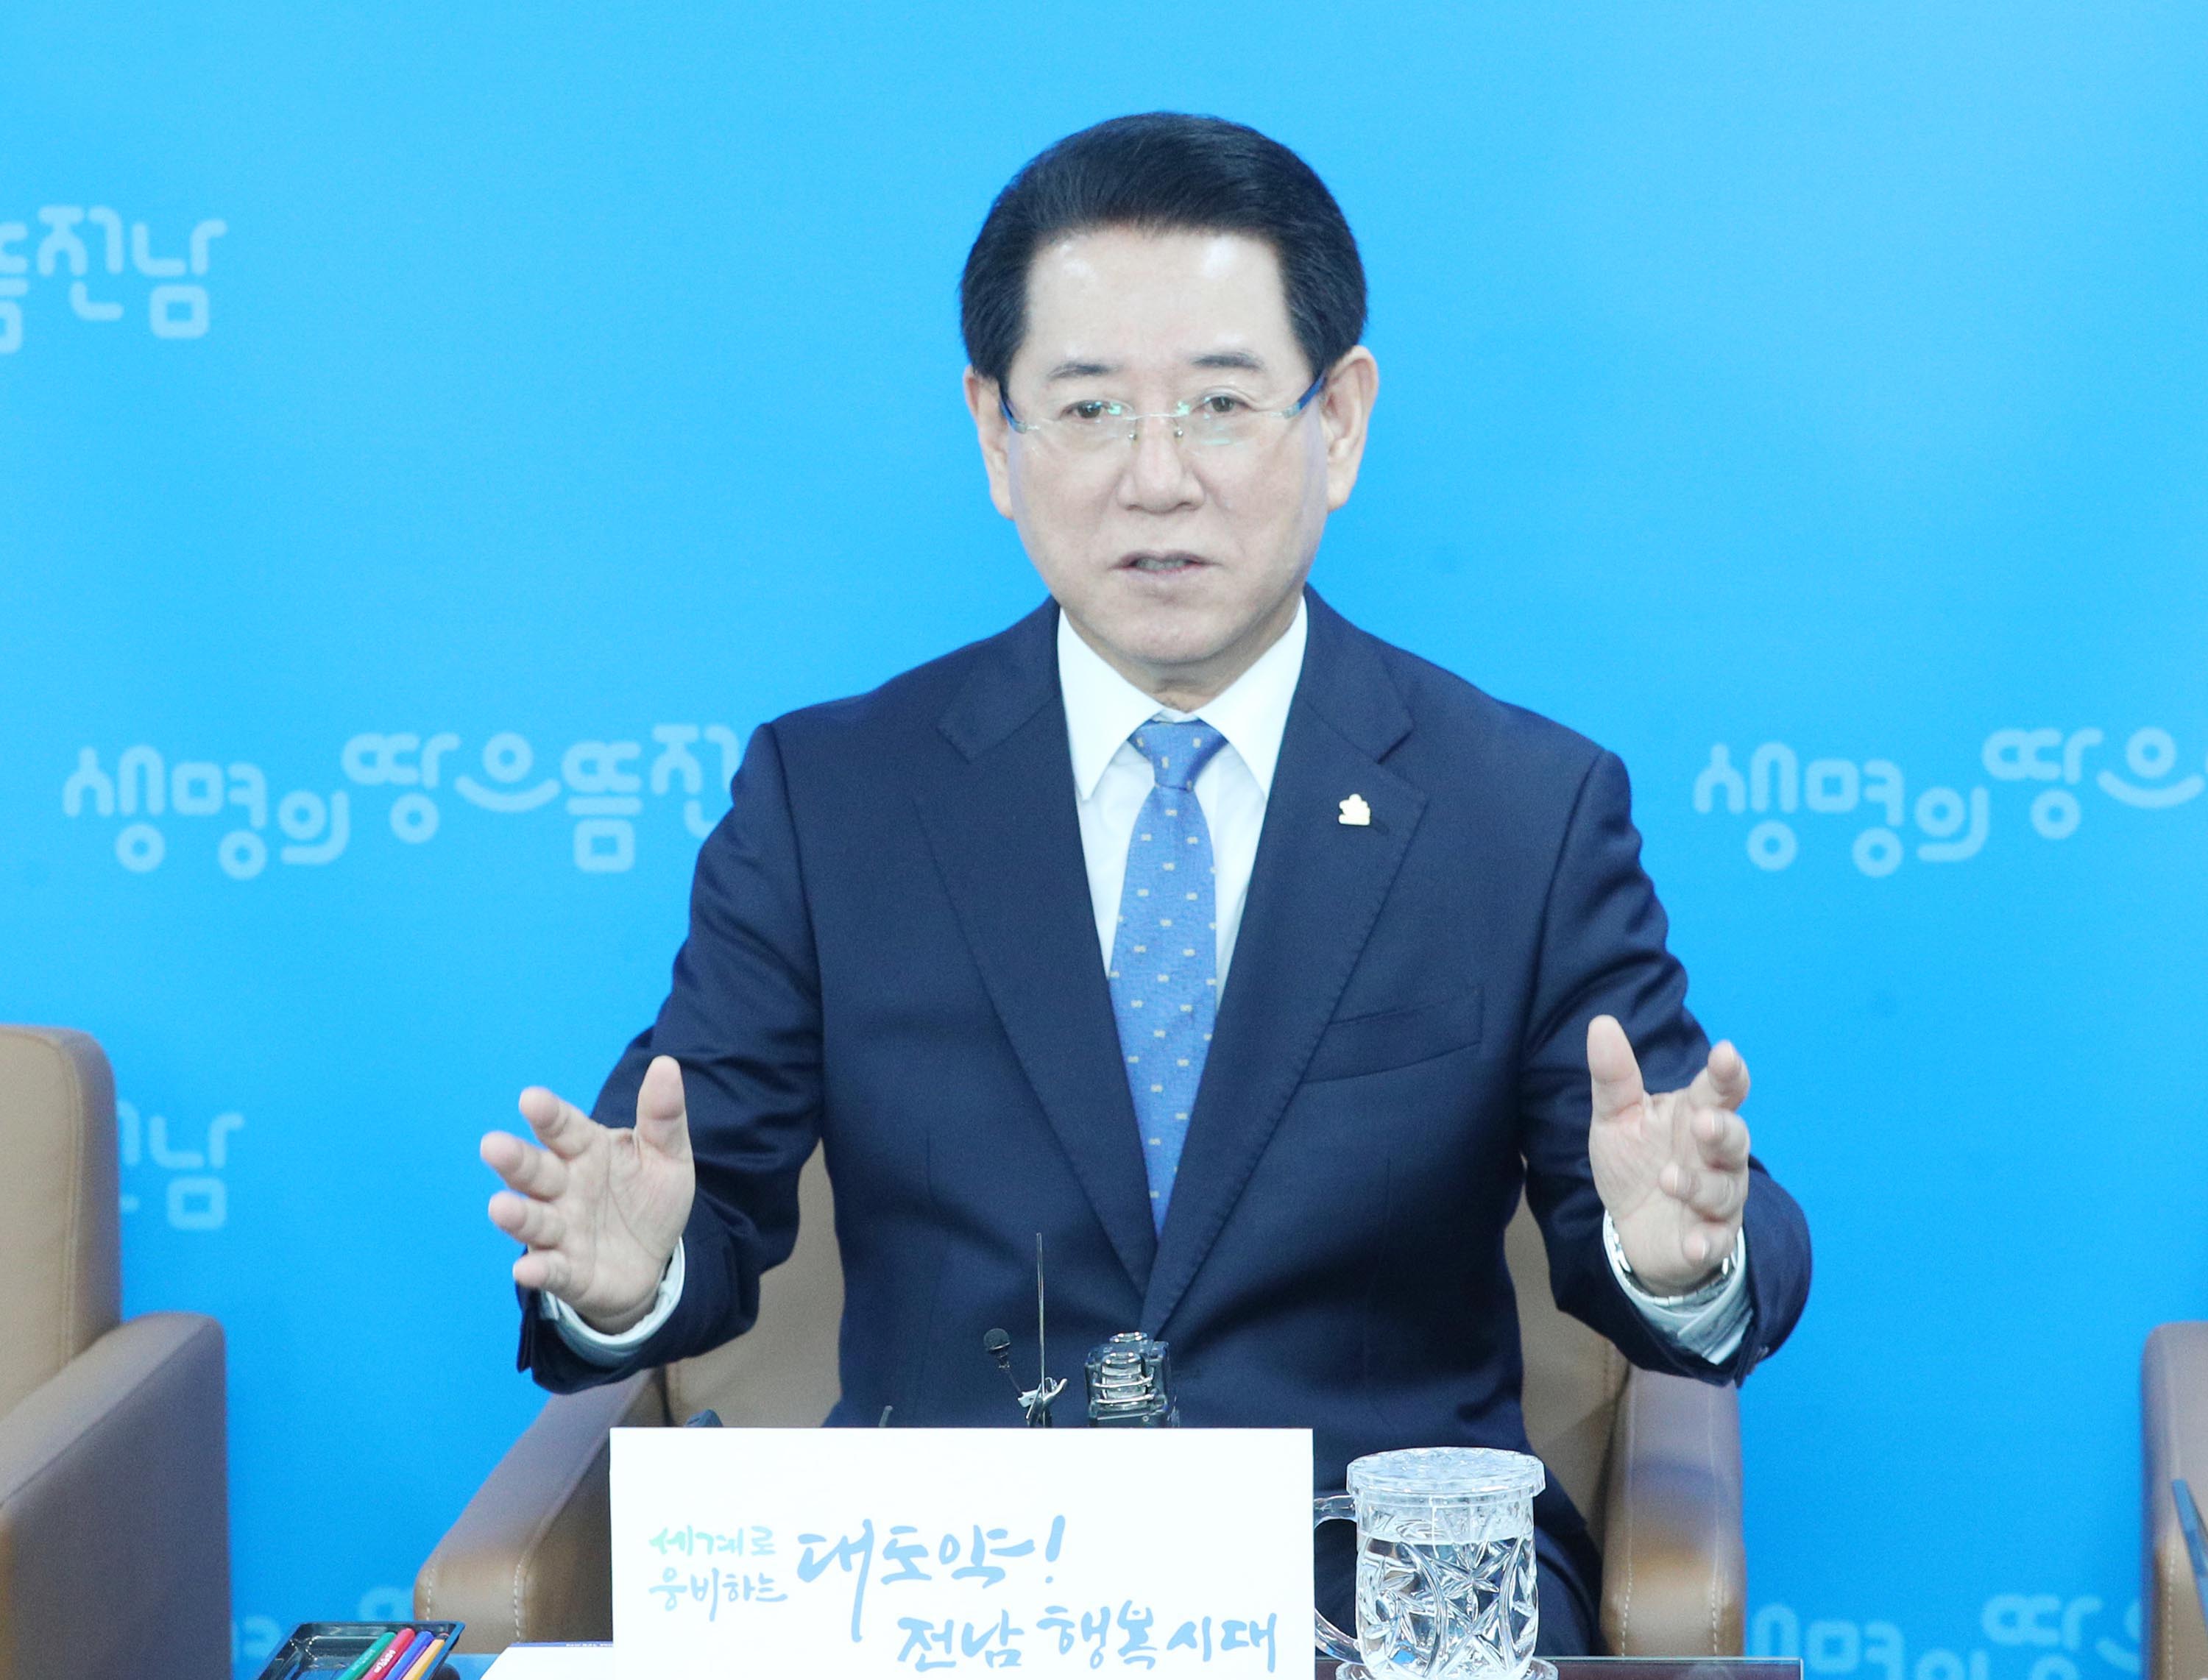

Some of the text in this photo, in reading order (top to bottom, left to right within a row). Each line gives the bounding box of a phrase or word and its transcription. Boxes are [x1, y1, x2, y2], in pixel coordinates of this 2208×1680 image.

[38, 205, 228, 339] 전남
[63, 745, 350, 880] 생명의
[651, 723, 738, 839] 전
[1693, 741, 1990, 877] 생명의
[2096, 726, 2208, 809] 으
[648, 1524, 776, 1556] 세계로
[648, 1567, 788, 1622] 웅비하는
[797, 1514, 1066, 1643] 대도약!
[897, 1609, 1025, 1673] 전남
